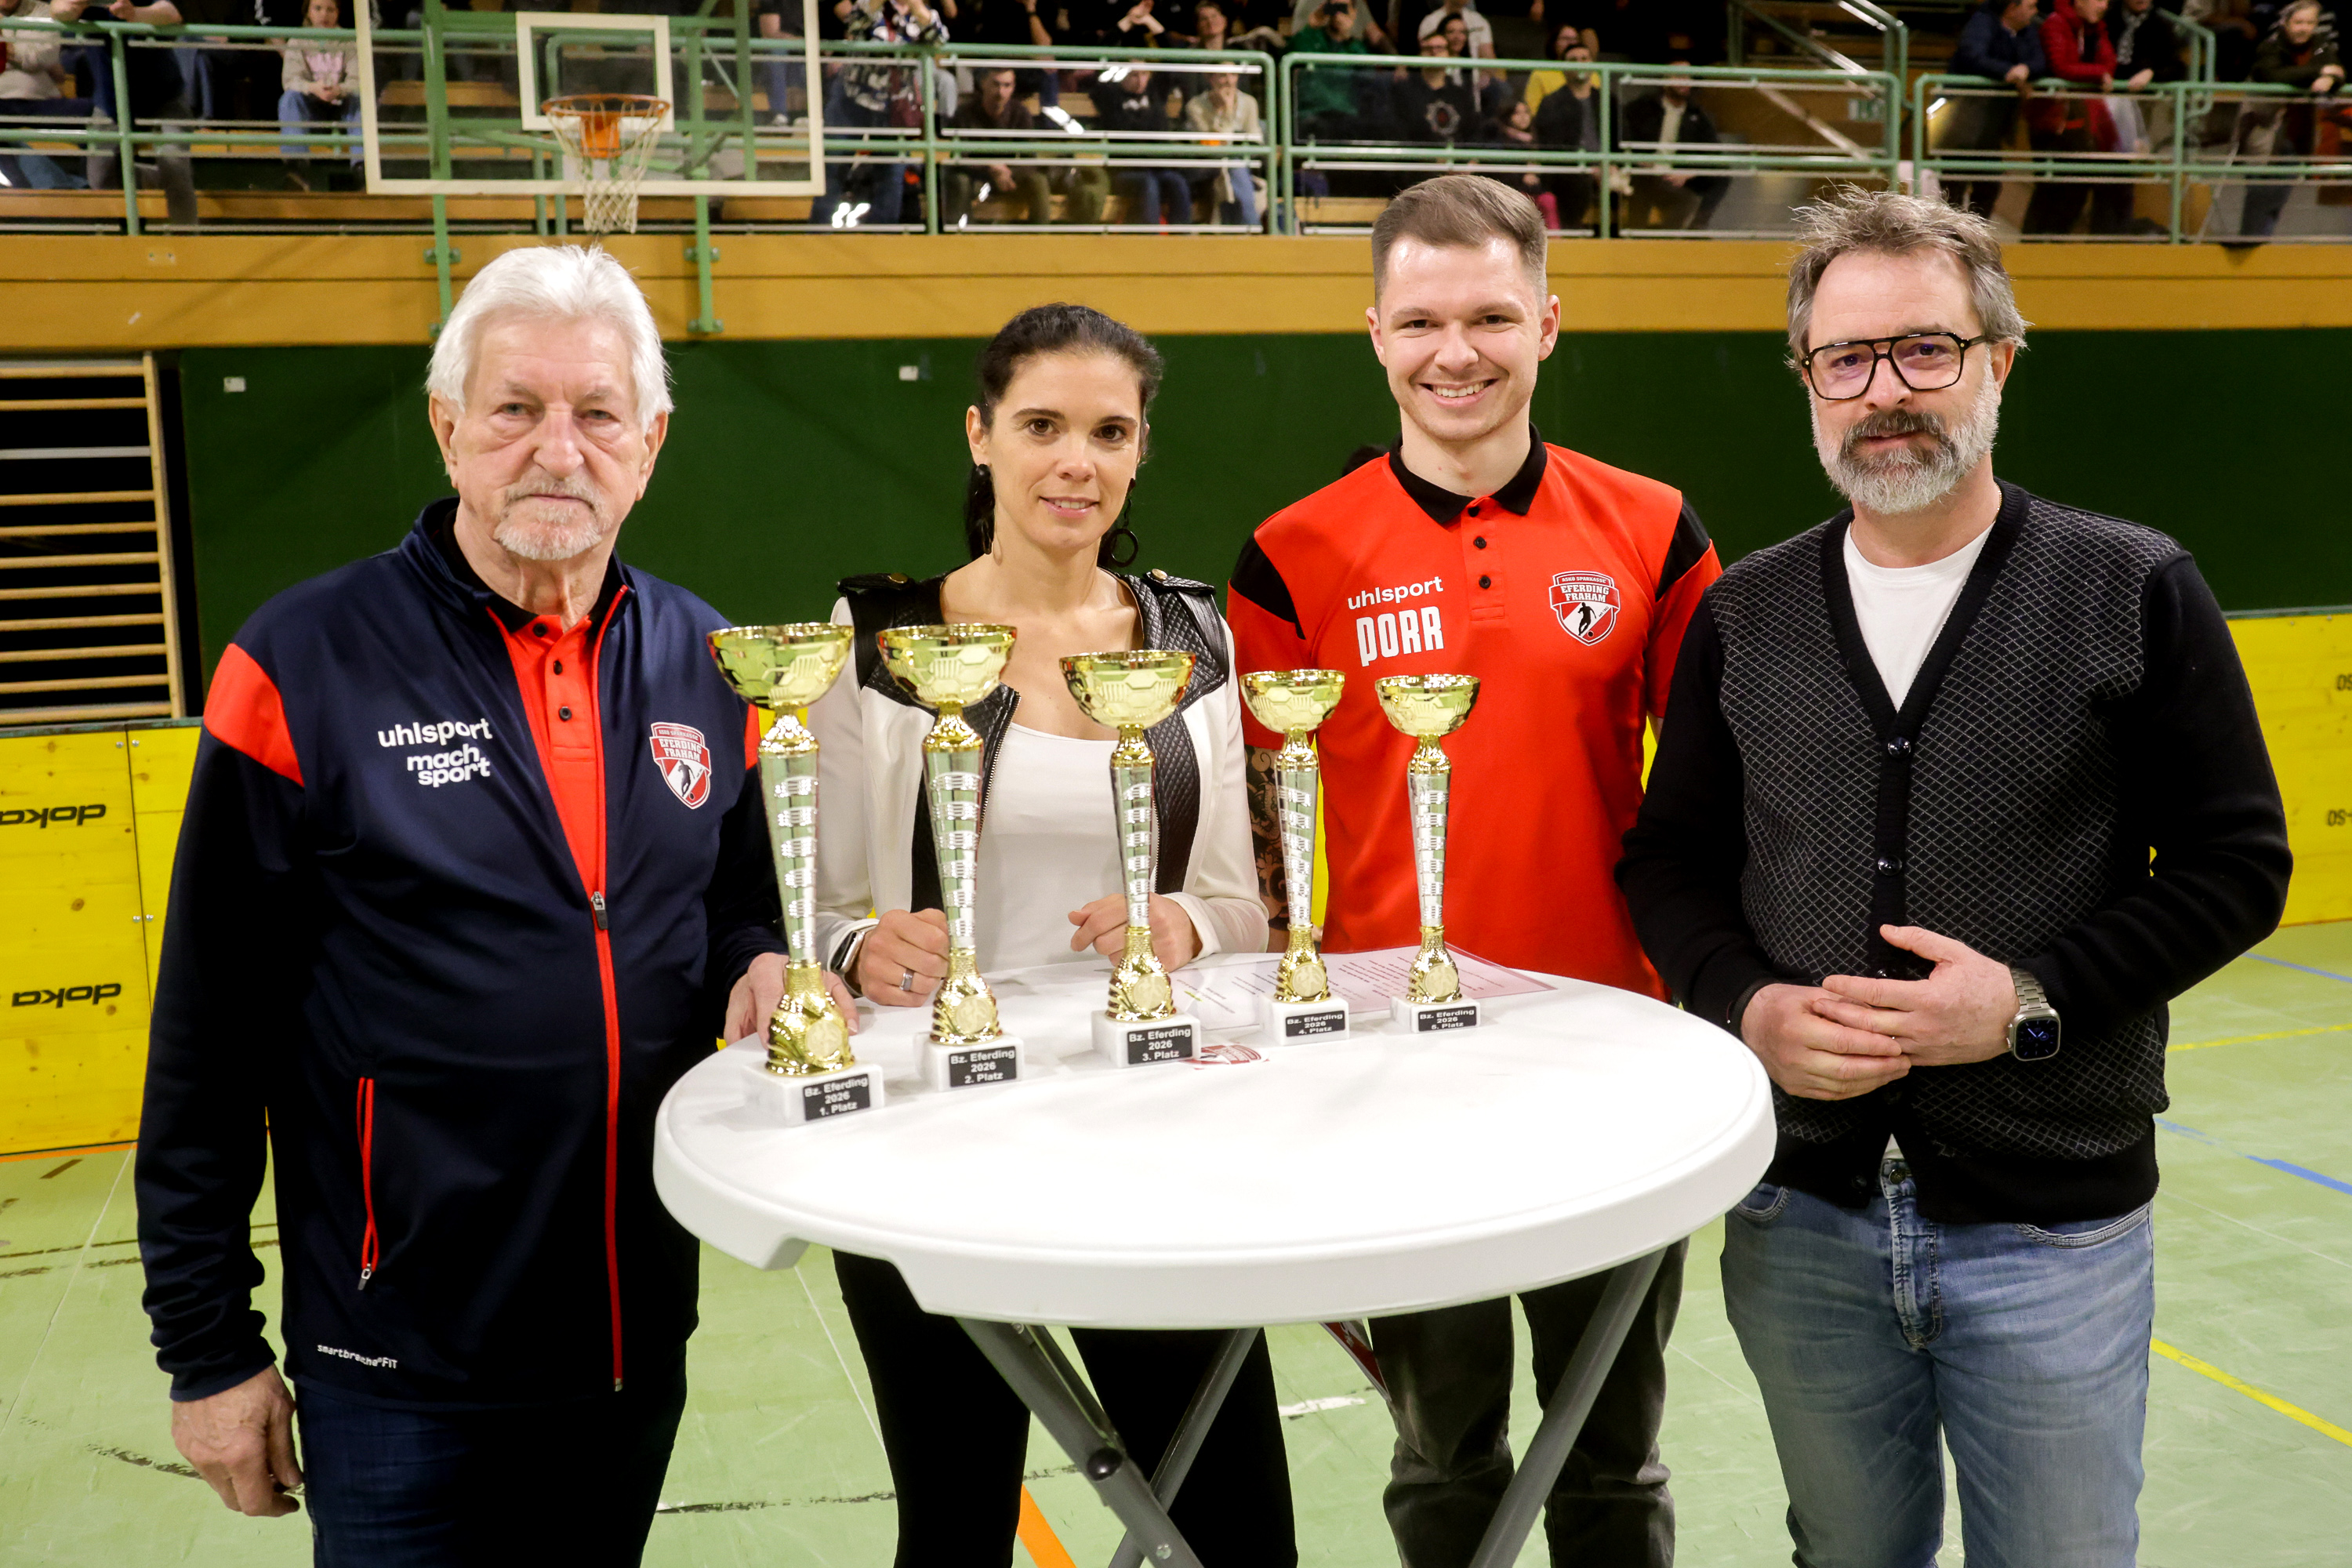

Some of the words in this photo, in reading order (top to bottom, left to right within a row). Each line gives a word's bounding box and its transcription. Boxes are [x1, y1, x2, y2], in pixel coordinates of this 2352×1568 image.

[1348, 576, 1444, 610] uhlsport
[1560, 584, 1610, 595] EFERDING
[1565, 593, 1606, 603] FRAHAM
[378, 718, 493, 747] uhlsport
[659, 738, 702, 754] EFERDING
[407, 744, 481, 771] mach
[663, 747, 701, 762] FRAHAM
[418, 759, 491, 787] sport
[12, 982, 122, 1008] doka
[1304, 1014, 1343, 1022] Eferding
[1129, 1033, 1145, 1042] Bz.
[1148, 1029, 1191, 1040] Eferding
[1149, 1040, 1173, 1051] 2026
[950, 1055, 968, 1065] Bz.
[971, 1050, 1015, 1062] Eferding
[1142, 1052, 1152, 1062] 3.
[1154, 1051, 1179, 1060] Platz
[971, 1062, 996, 1073] 2026
[964, 1074, 975, 1083] 2.
[977, 1072, 1004, 1082] Platz
[804, 1087, 822, 1098] Bz.
[823, 1077, 868, 1093] Eferding
[825, 1091, 851, 1105] 2026
[819, 1107, 829, 1116] 1.
[831, 1102, 858, 1114] Platz
